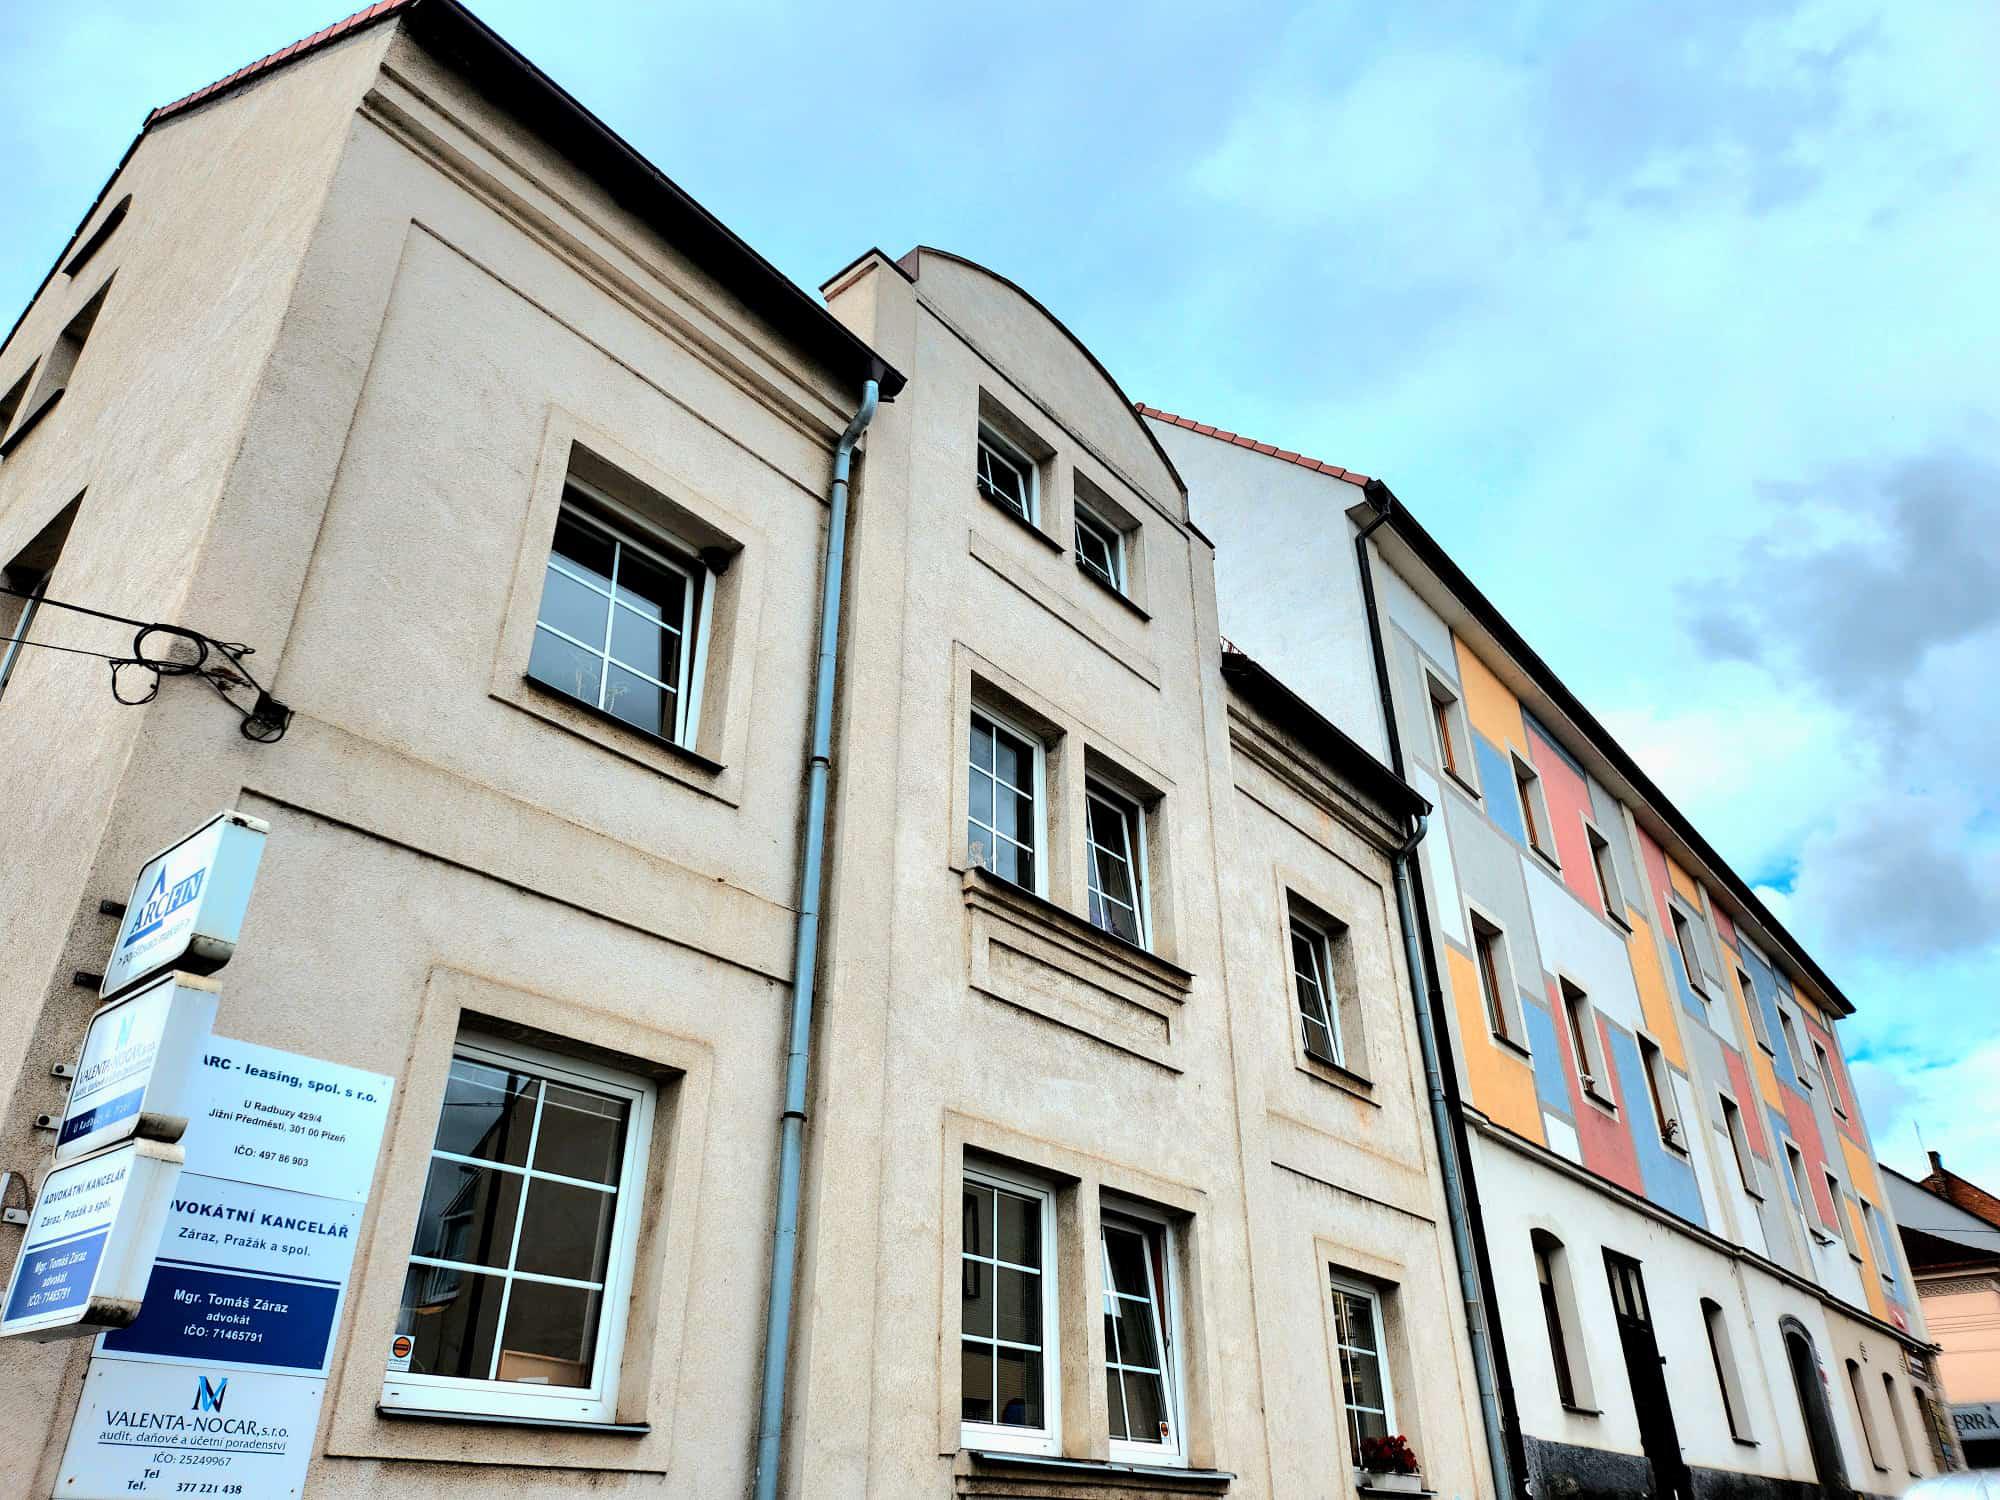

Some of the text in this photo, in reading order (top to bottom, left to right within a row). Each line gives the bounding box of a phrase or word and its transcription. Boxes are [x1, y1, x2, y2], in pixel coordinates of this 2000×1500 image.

[245, 1063, 303, 1088] leasing,
[308, 1079, 341, 1095] spol.
[345, 1088, 353, 1098] s
[357, 1091, 377, 1103] r.o.
[244, 1100, 322, 1123] U Radbuzy 429/4
[208, 1108, 233, 1121] Jižní
[289, 1124, 306, 1135] 301
[307, 1128, 320, 1138] 00
[321, 1130, 346, 1143] Plzeň
[234, 1145, 309, 1167] IČO: 497 86 903
[170, 1200, 349, 1238] VOKÁTNÍ KANCELÁŘ
[178, 1227, 311, 1256] Záraz, Pražák a spol.
[174, 1288, 288, 1313] Mgr. Tomáš Záraz
[206, 1311, 250, 1325] advokát
[184, 1323, 263, 1343] IČO: 71465791
[136, 1432, 178, 1444] daňové
[190, 1435, 223, 1447] účetní
[225, 1438, 287, 1451] poradenství
[153, 1452, 232, 1467] IČO: 25249967
[144, 1468, 160, 1479] Tel
[127, 1480, 243, 1495] Tel. 377 221 438
